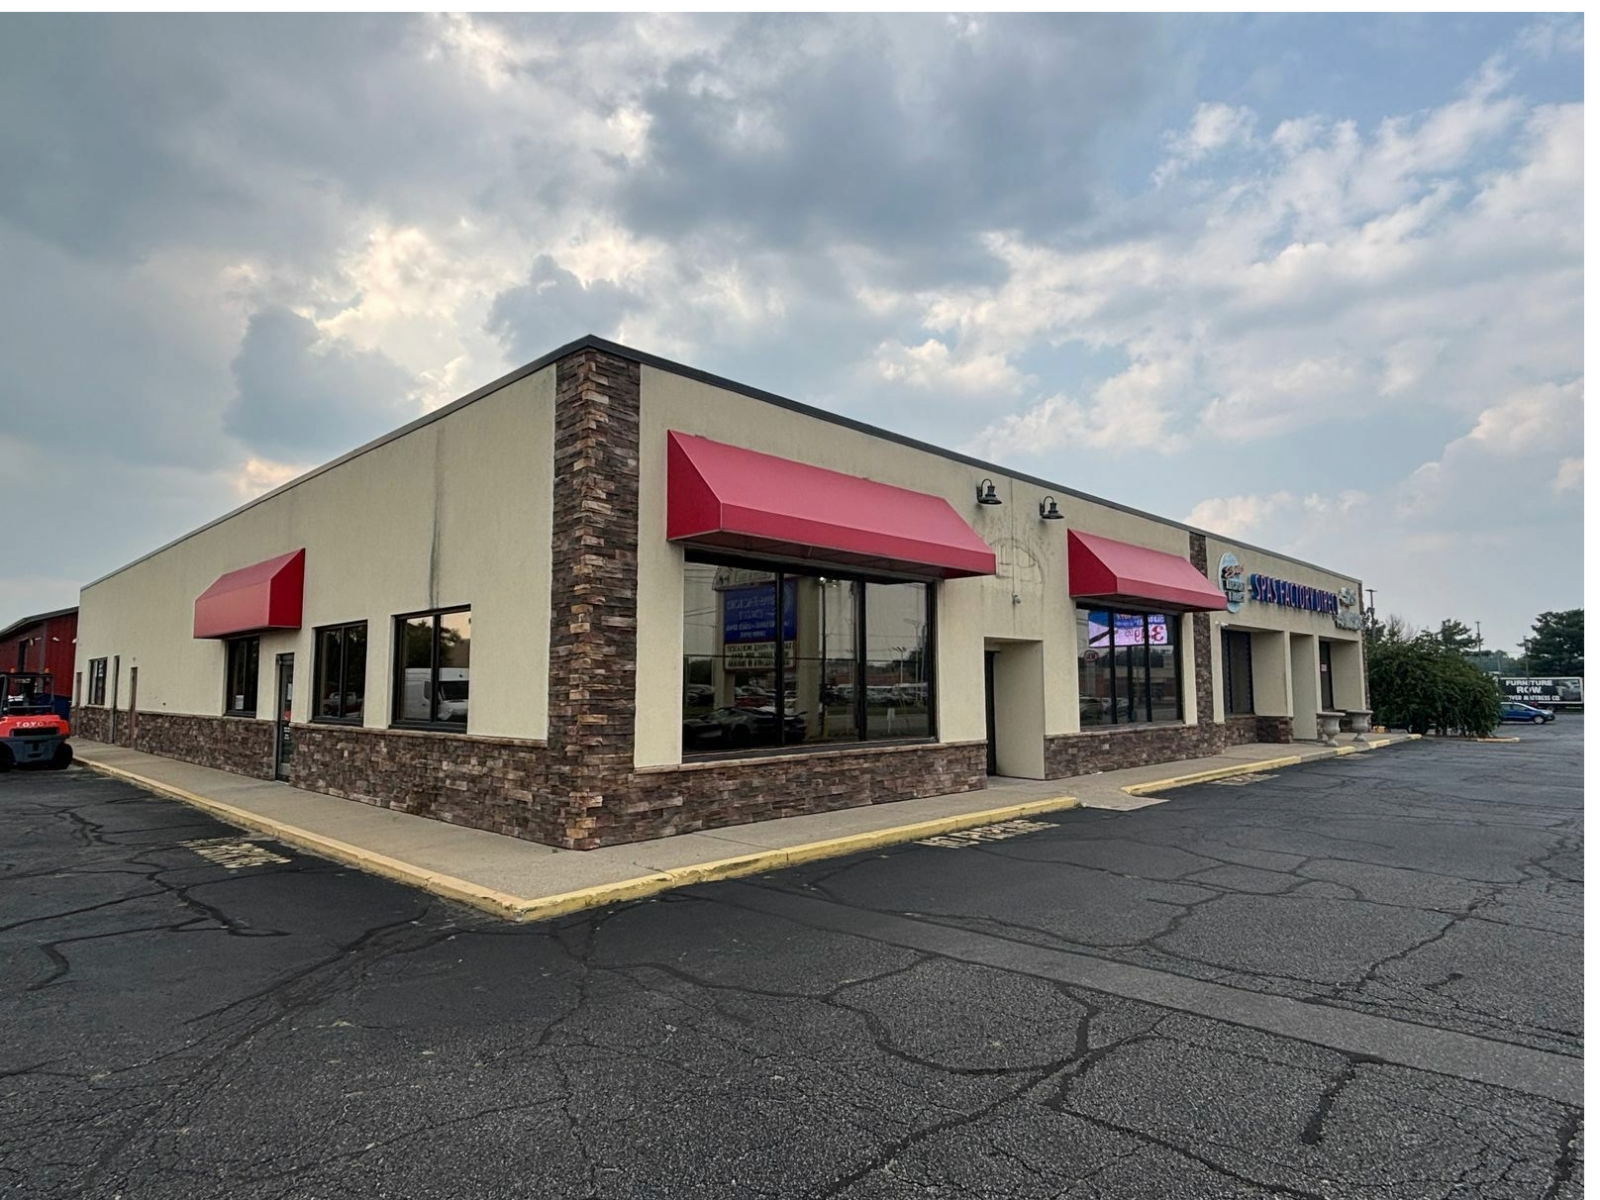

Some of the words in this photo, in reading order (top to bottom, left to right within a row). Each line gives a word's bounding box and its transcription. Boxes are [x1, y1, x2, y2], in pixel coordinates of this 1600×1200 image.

[1252, 573, 1278, 604] SPAS
[1280, 579, 1315, 611] FACTORY
[1516, 686, 1542, 694] ROW
